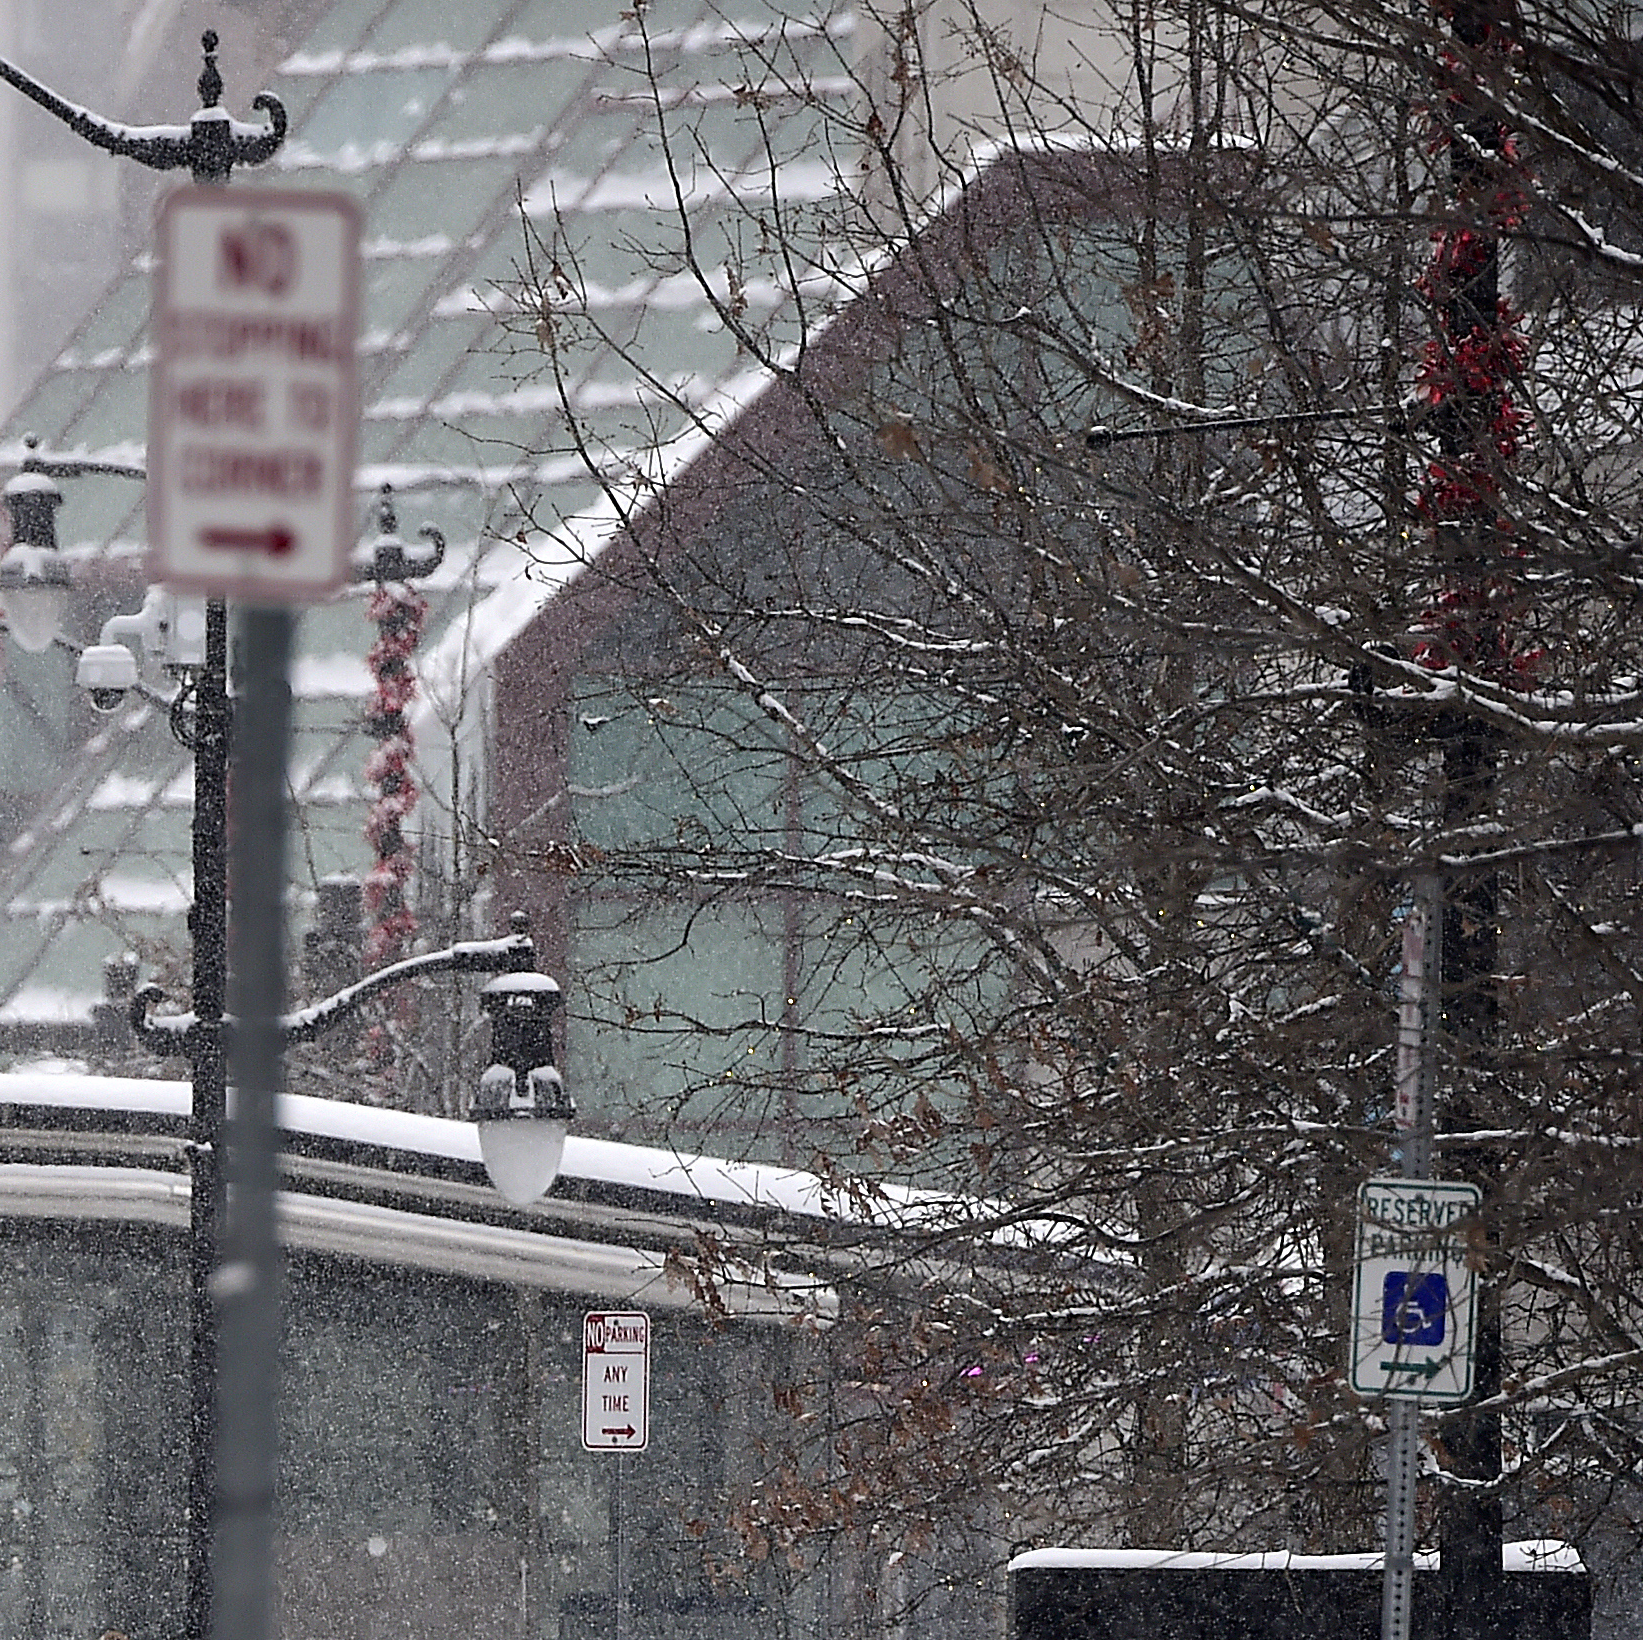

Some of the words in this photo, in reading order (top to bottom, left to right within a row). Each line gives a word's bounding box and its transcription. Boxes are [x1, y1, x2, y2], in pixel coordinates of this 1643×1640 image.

[218, 221, 299, 299] NO
[587, 1320, 604, 1348] NO
[605, 1326, 645, 1344] PARKING
[603, 1365, 628, 1383] ANY
[601, 1394, 630, 1412] TIME
